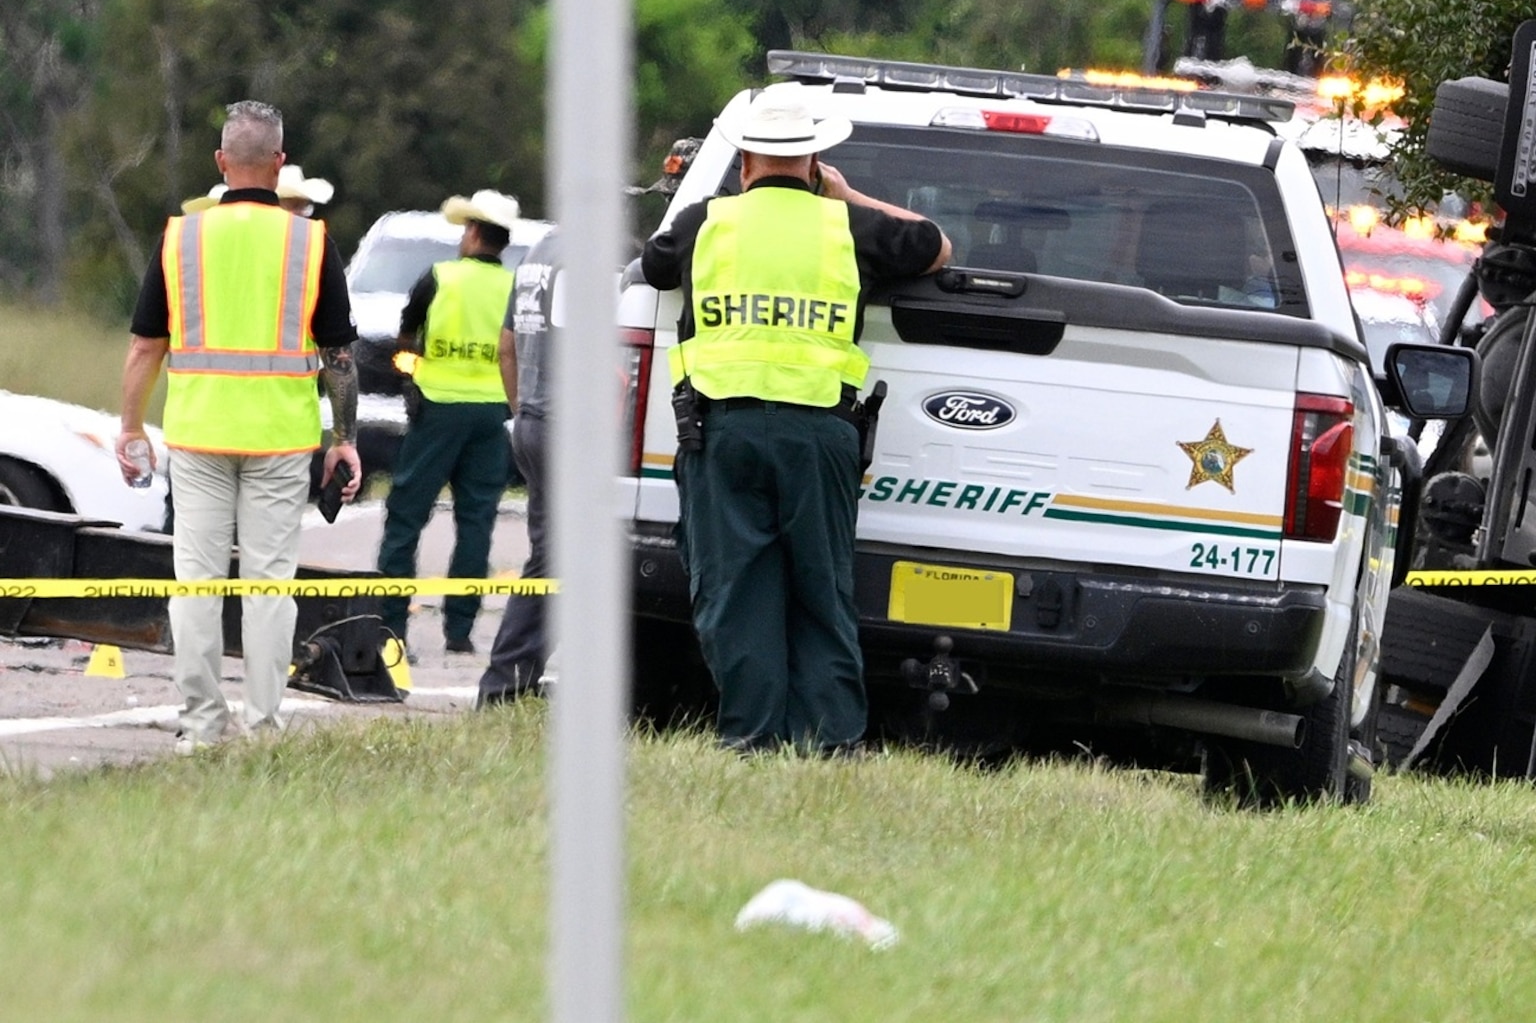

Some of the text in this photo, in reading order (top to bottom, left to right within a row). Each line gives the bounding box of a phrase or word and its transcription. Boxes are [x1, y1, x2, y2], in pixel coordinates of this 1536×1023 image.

[700, 294, 848, 333] SHERIFF
[938, 394, 1000, 425] Ford
[868, 476, 1051, 516] SHERIFF
[1190, 543, 1275, 574] 24-177
